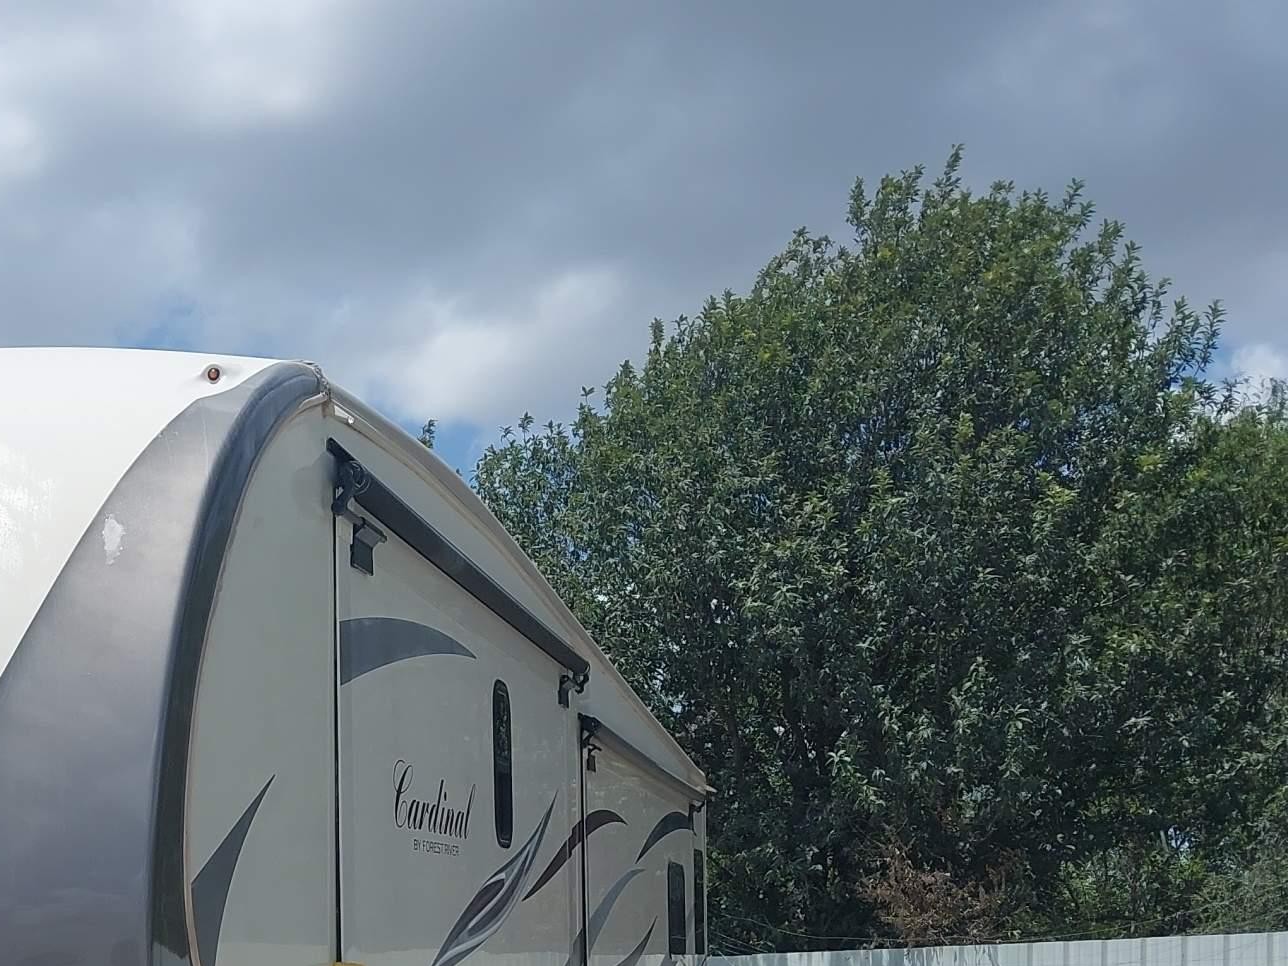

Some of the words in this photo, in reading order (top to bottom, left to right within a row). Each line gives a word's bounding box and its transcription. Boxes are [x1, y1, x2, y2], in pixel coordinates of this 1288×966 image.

[393, 760, 476, 839] Cardinal
[413, 839, 421, 852] BY
[422, 840, 444, 854] FOREST
[444, 843, 460, 857] RIVER
